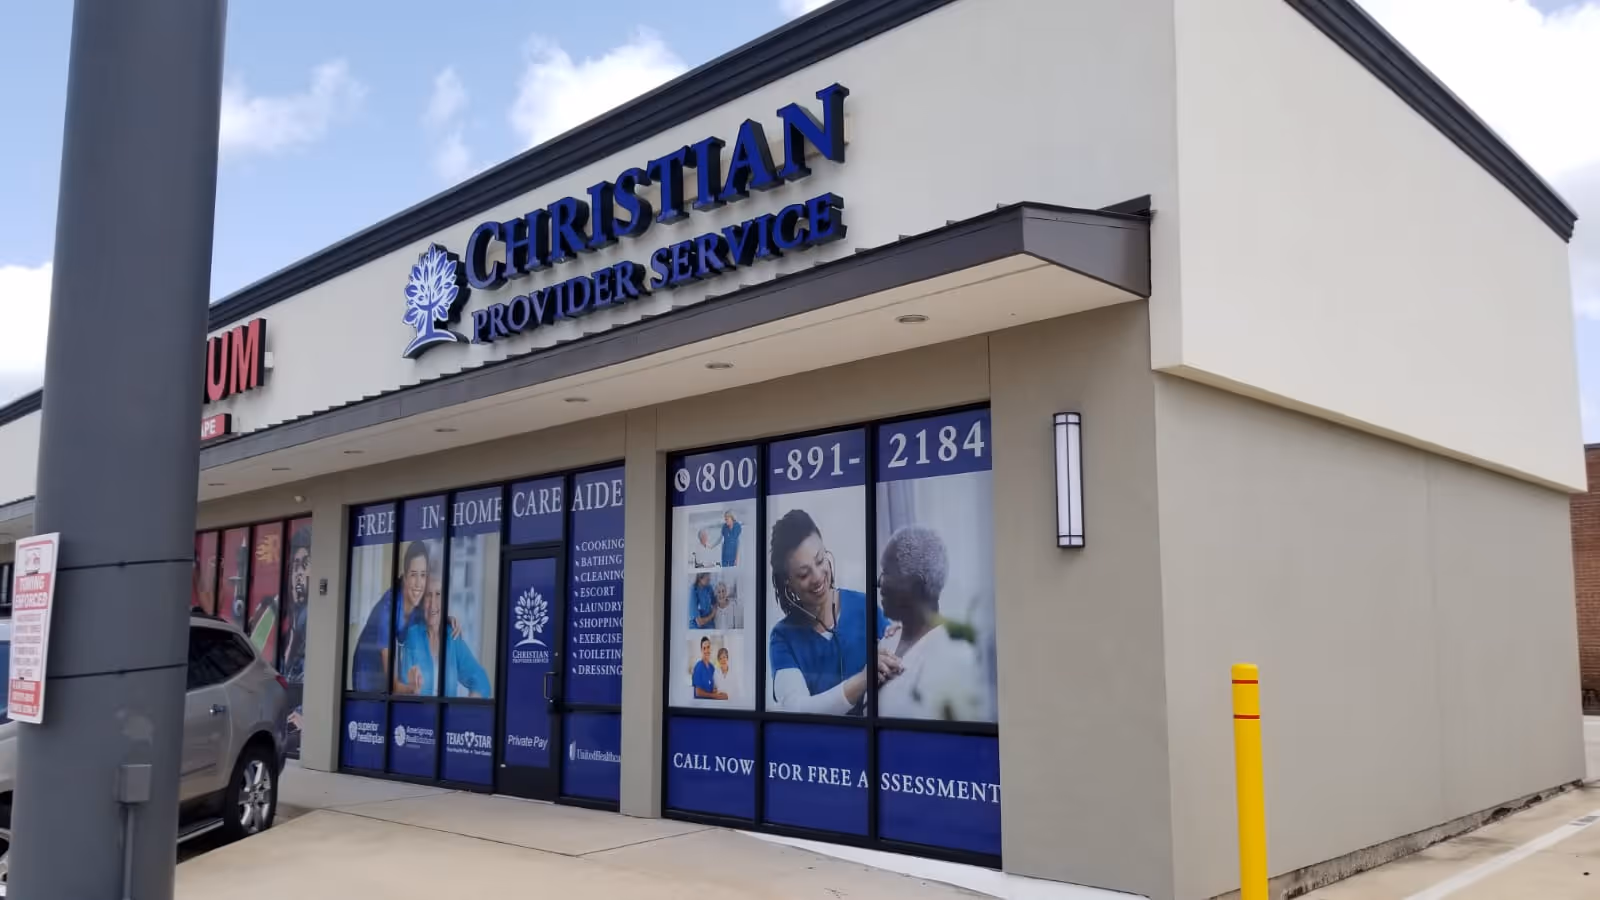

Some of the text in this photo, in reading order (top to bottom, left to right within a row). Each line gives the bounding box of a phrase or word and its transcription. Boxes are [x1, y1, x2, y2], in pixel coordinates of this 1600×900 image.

[465, 82, 849, 290] CHRISTIAN
[471, 192, 847, 344] PROVIDER SERVICE
[888, 420, 985, 469] 2184
[357, 510, 395, 537] FREE
[512, 487, 561, 518] CARE
[569, 479, 623, 512] AIDE
[581, 538, 624, 552] COOKING
[581, 554, 622, 567] BATHING
[580, 586, 615, 598] ESCORT
[580, 601, 623, 612] LAUNDRY
[579, 633, 623, 644] EXERCISE
[512, 650, 549, 659] CHRISTIAN
[579, 649, 622, 660] TOILETIN
[578, 665, 623, 675] DRESSING
[446, 732, 465, 746] TEXAS
[474, 734, 492, 749] STAR
[507, 734, 549, 750] Private Pay
[577, 748, 620, 763] UnitedHealthca
[673, 752, 711, 772] CALL
[715, 756, 755, 775] NOW
[768, 762, 803, 782] FOR
[808, 766, 852, 786] FREE
